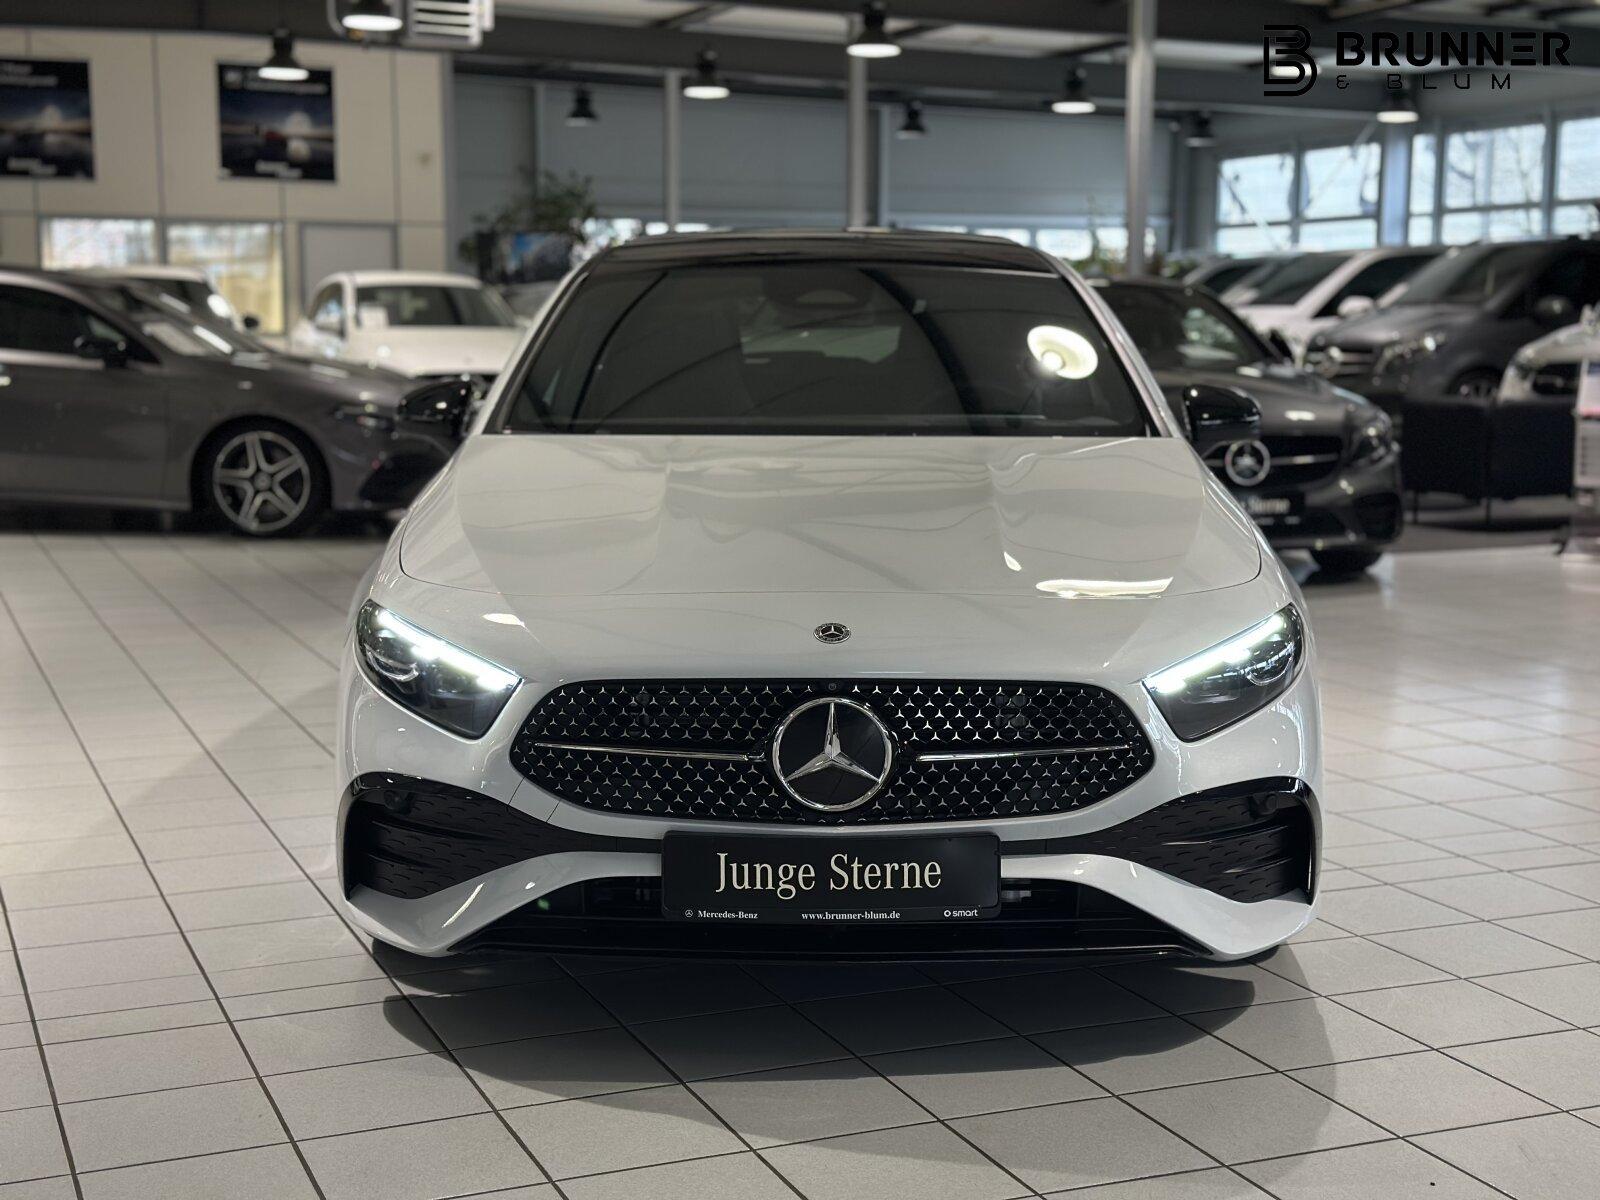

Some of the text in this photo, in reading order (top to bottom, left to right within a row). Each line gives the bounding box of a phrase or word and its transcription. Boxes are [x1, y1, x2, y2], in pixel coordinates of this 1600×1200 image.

[715, 852, 942, 900] Junge Sterne
[697, 909, 979, 921] Mercedes-Benz www.brunner-blum.de smart
